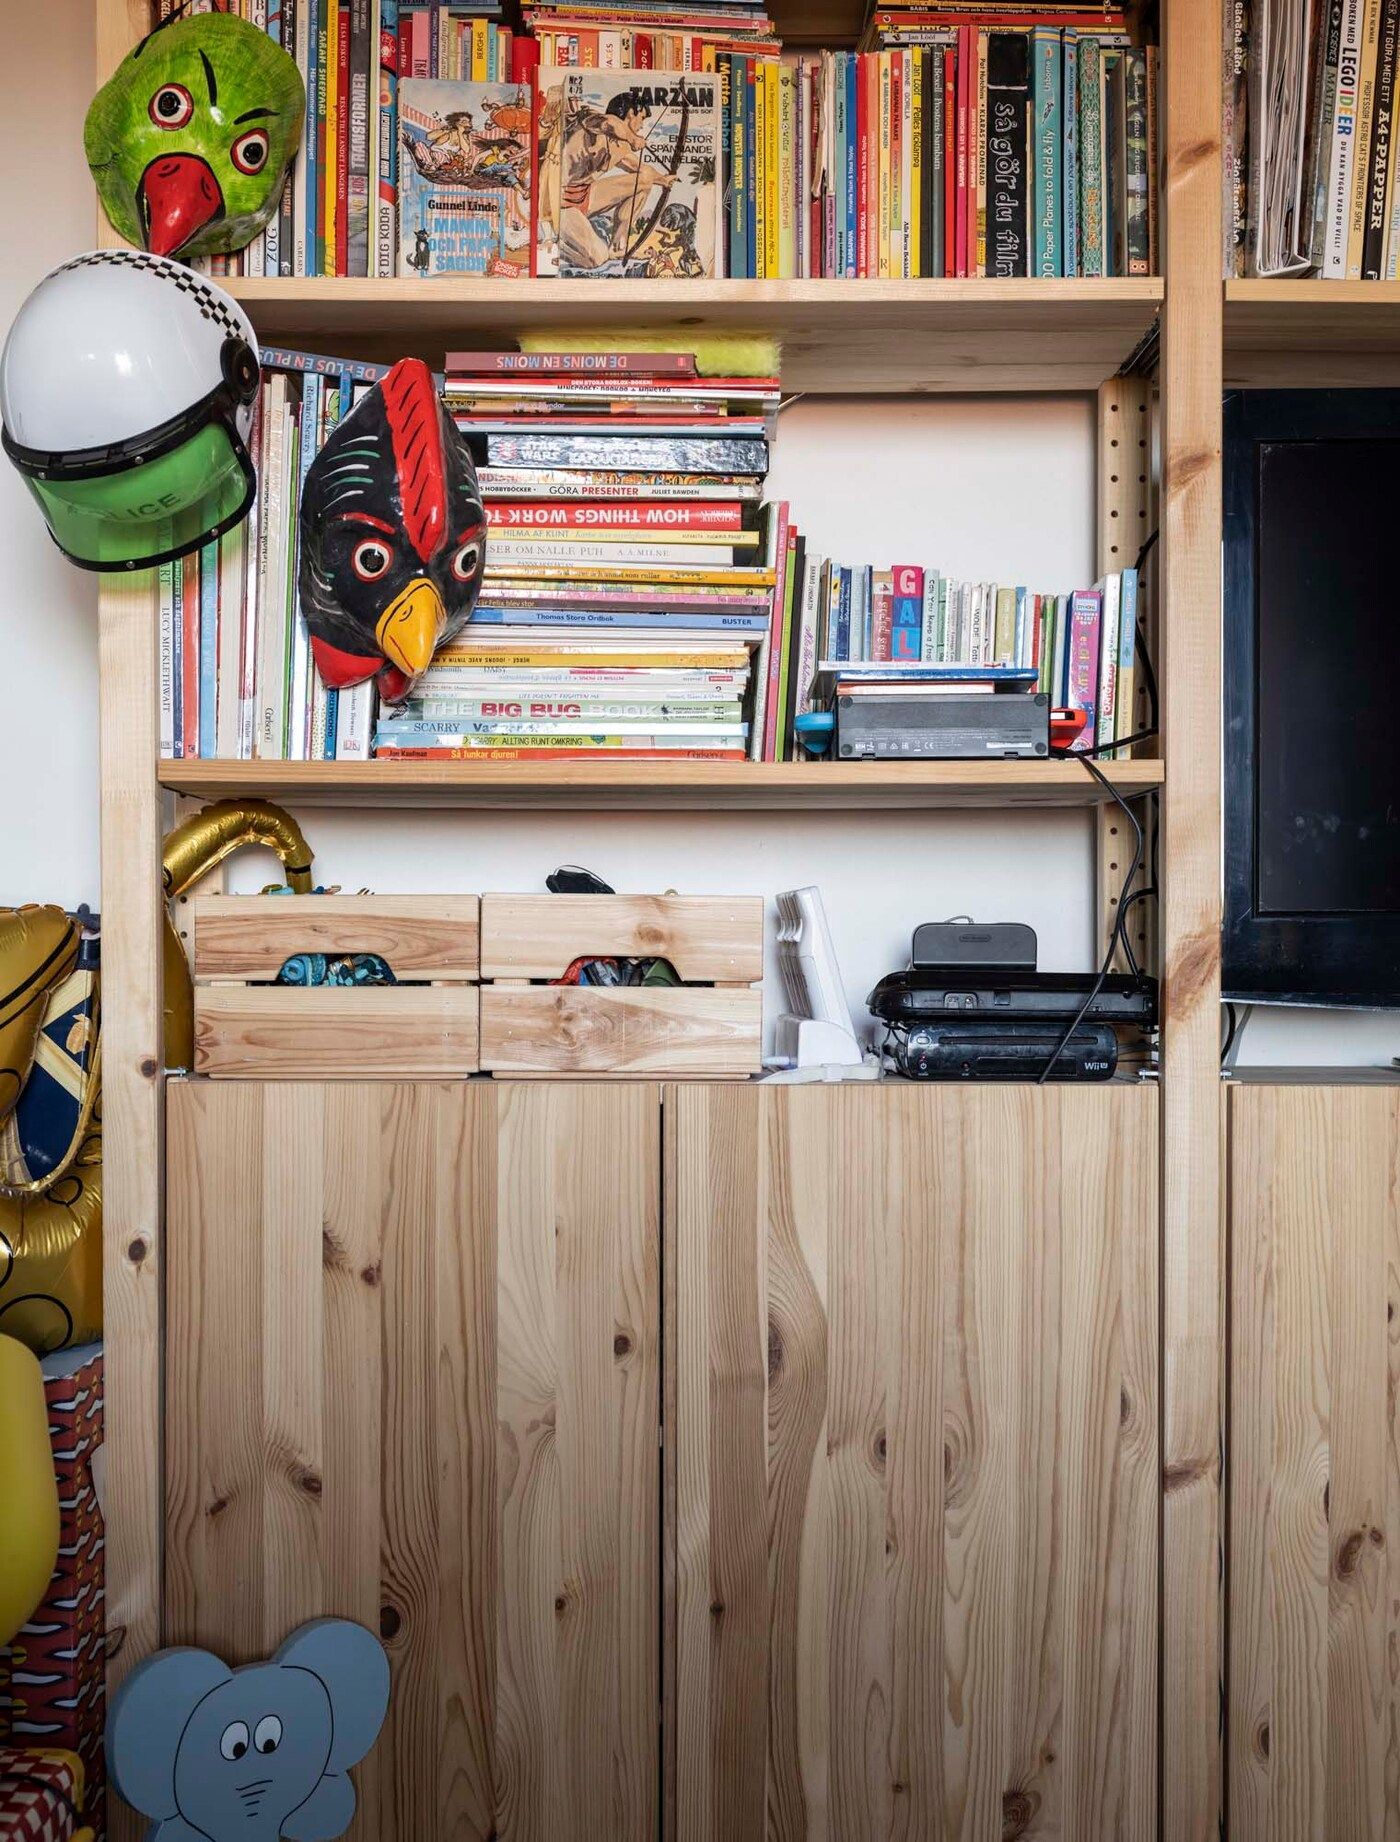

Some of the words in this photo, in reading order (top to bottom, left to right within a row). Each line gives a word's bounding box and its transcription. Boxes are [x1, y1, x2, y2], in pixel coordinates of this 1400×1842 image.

[1346, 26, 1356, 45] MED
[1367, 19, 1377, 45] NEWMAN
[1385, 17, 1396, 36] ATT
[318, 30, 327, 64] SARAH
[908, 33, 920, 41] Jan
[933, 51, 943, 67] Eva
[1383, 37, 1395, 63] GÖRA
[912, 63, 922, 77] Jan
[979, 58, 987, 69] Pat
[1340, 47, 1358, 88] LEGO
[1382, 63, 1392, 84] MED
[912, 78, 922, 97] Lööf
[933, 67, 943, 94] Bexell
[979, 70, 987, 100] Hutchins
[307, 84, 316, 113] kommer
[318, 68, 327, 116] SHEPPARD
[629, 86, 714, 107] TARZAN
[1323, 71, 1336, 126] MATTER
[1361, 80, 1373, 120] PROFESSOR
[1380, 85, 1389, 104] ETT
[719, 61, 731, 152] Mattelabbet
[933, 97, 943, 132] Prostens
[351, 74, 367, 169] TRANSFORMER
[912, 106, 922, 130] Pelles
[979, 109, 987, 138] KLARAS
[993, 102, 1018, 133] Så
[684, 134, 713, 144] STOR
[1040, 129, 1057, 144] fly
[1359, 121, 1370, 143] ASTRO
[912, 131, 922, 168] ficklampa
[1041, 145, 1055, 154] &
[1341, 141, 1348, 151] DU
[979, 140, 987, 187] PROMENAD
[988, 137, 1020, 191] gör
[1040, 155, 1055, 179] fold
[1339, 154, 1347, 170] KAN
[1370, 108, 1392, 230] A4-PAPPER
[1042, 180, 1055, 193] to
[1337, 172, 1346, 196] BYGGA
[1354, 162, 1367, 200] FRONTIERS
[427, 199, 467, 212] Gunnel
[468, 201, 498, 213] Linde
[994, 191, 1019, 222] du
[1040, 193, 1055, 226] Planes
[1354, 200, 1362, 210] OF
[382, 207, 391, 240] KODA
[1335, 216, 1343, 227] DU
[1352, 211, 1363, 233] SPACE
[994, 229, 1020, 278] film
[1041, 229, 1058, 259] Paper
[382, 243, 391, 267] DIG
[294, 356, 314, 371] EN
[496, 355, 540, 369] MOINS
[542, 355, 561, 369] EN
[563, 355, 607, 369] MOINS
[608, 355, 628, 369] DE
[356, 365, 377, 381] DE
[548, 484, 579, 496] GÖRA
[581, 485, 639, 496] PRESENTER
[507, 507, 567, 522] WORK
[575, 508, 640, 523] THINGS
[646, 508, 690, 523] HOW
[502, 529, 529, 538] HILMA
[515, 546, 533, 554] OM
[536, 546, 576, 556] NALLE
[579, 547, 603, 557] PUH
[161, 607, 171, 631] LUCY
[536, 613, 565, 621] Thomas
[587, 615, 614, 623] Ordbok
[721, 615, 752, 623] BUSTER
[161, 635, 171, 712] MICKLETHWAIT
[431, 702, 474, 718] THE
[481, 702, 522, 718] BIG
[529, 702, 581, 719] BUG
[589, 703, 658, 718] BOOK
[412, 721, 461, 734] SCARRY
[501, 736, 530, 746] ALLTING
[530, 736, 550, 746] RUNT
[550, 736, 584, 746] OMKRING
[450, 749, 463, 759] Så
[463, 750, 489, 759] funkar
[490, 750, 519, 761] djuren!
